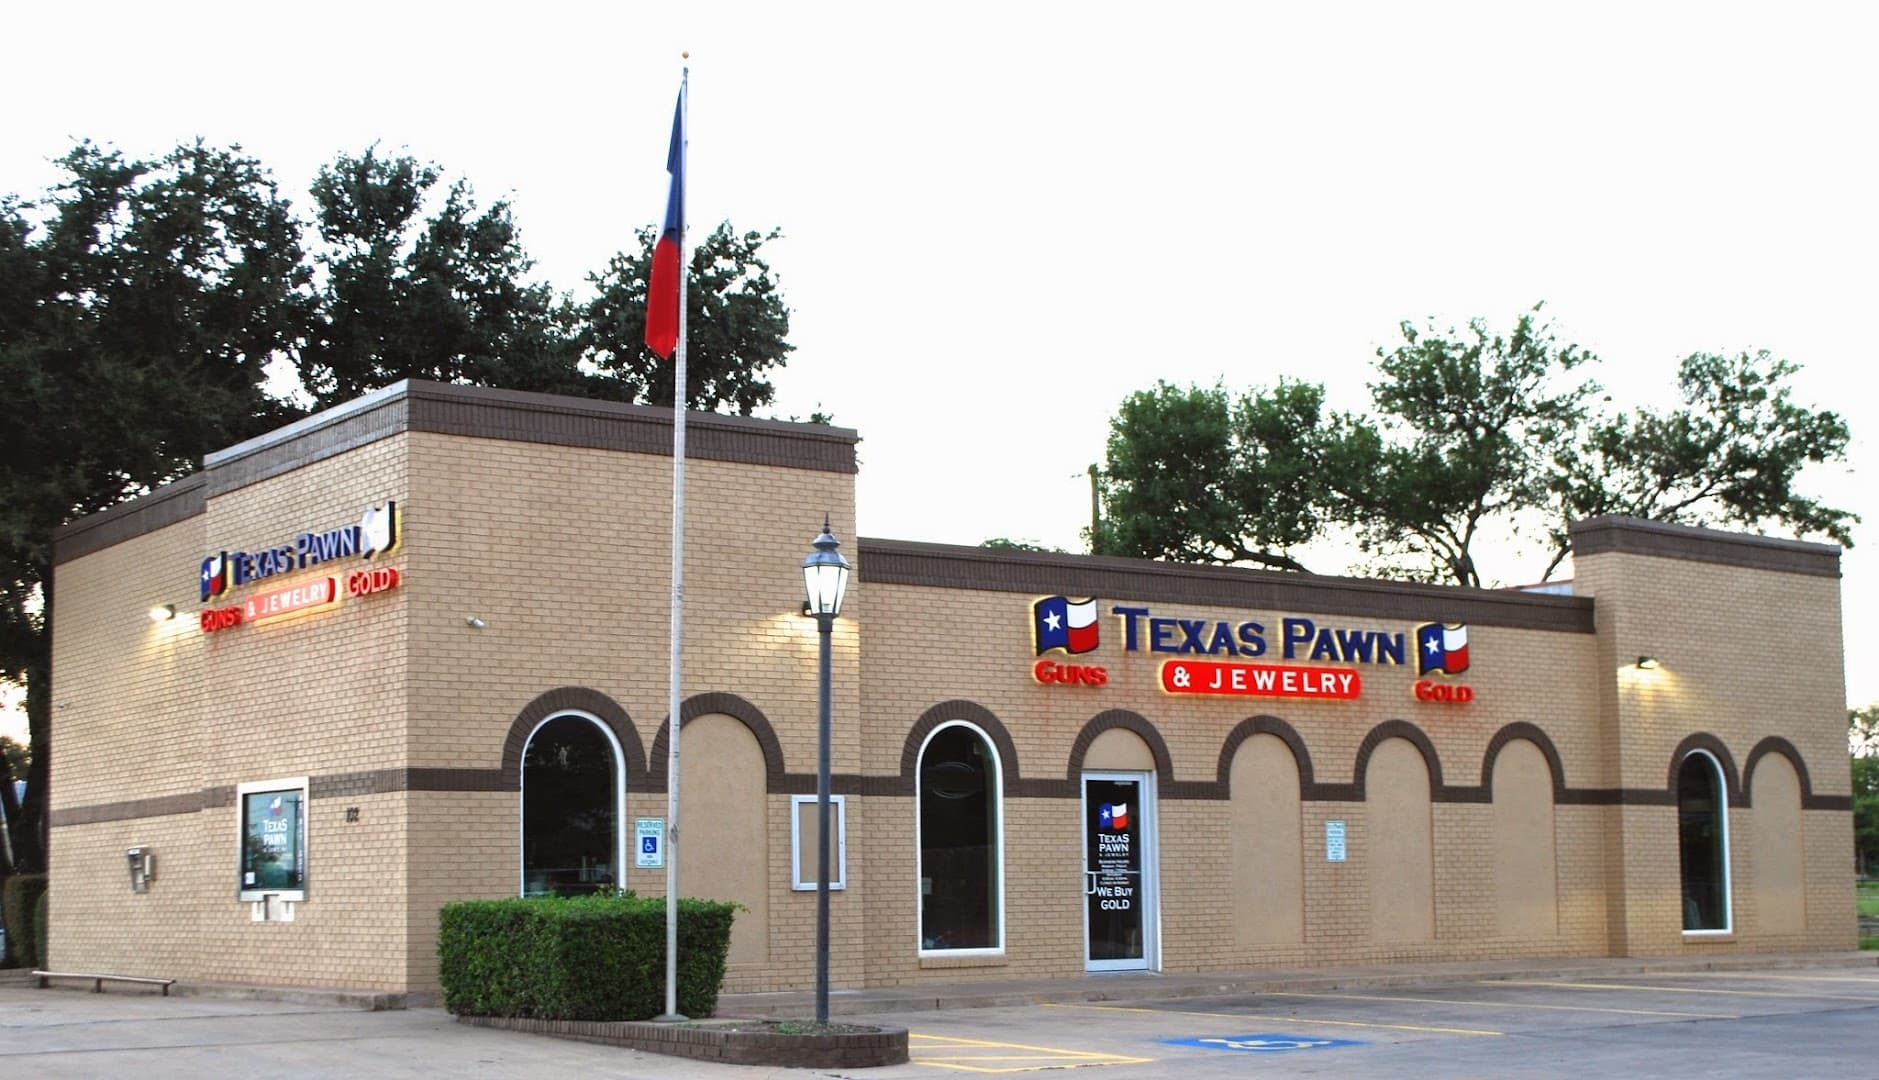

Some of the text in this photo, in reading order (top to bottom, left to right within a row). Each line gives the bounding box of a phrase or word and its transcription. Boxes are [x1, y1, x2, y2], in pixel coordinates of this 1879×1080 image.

[230, 525, 361, 586] TEXAS PAWN
[347, 567, 399, 597] GOLD
[247, 581, 329, 617] & JEWELRY
[201, 606, 242, 632] GUNS
[1112, 605, 1405, 665] TEXAS PAWN
[1034, 659, 1108, 686] GUNS
[1172, 666, 1353, 694] & JEWELRY
[1414, 680, 1473, 703] GOLD
[1097, 833, 1130, 843] TEXAS
[1099, 843, 1129, 852] PAWN
[1096, 886, 1133, 897] WE BUY
[1100, 899, 1130, 910] GOLD
